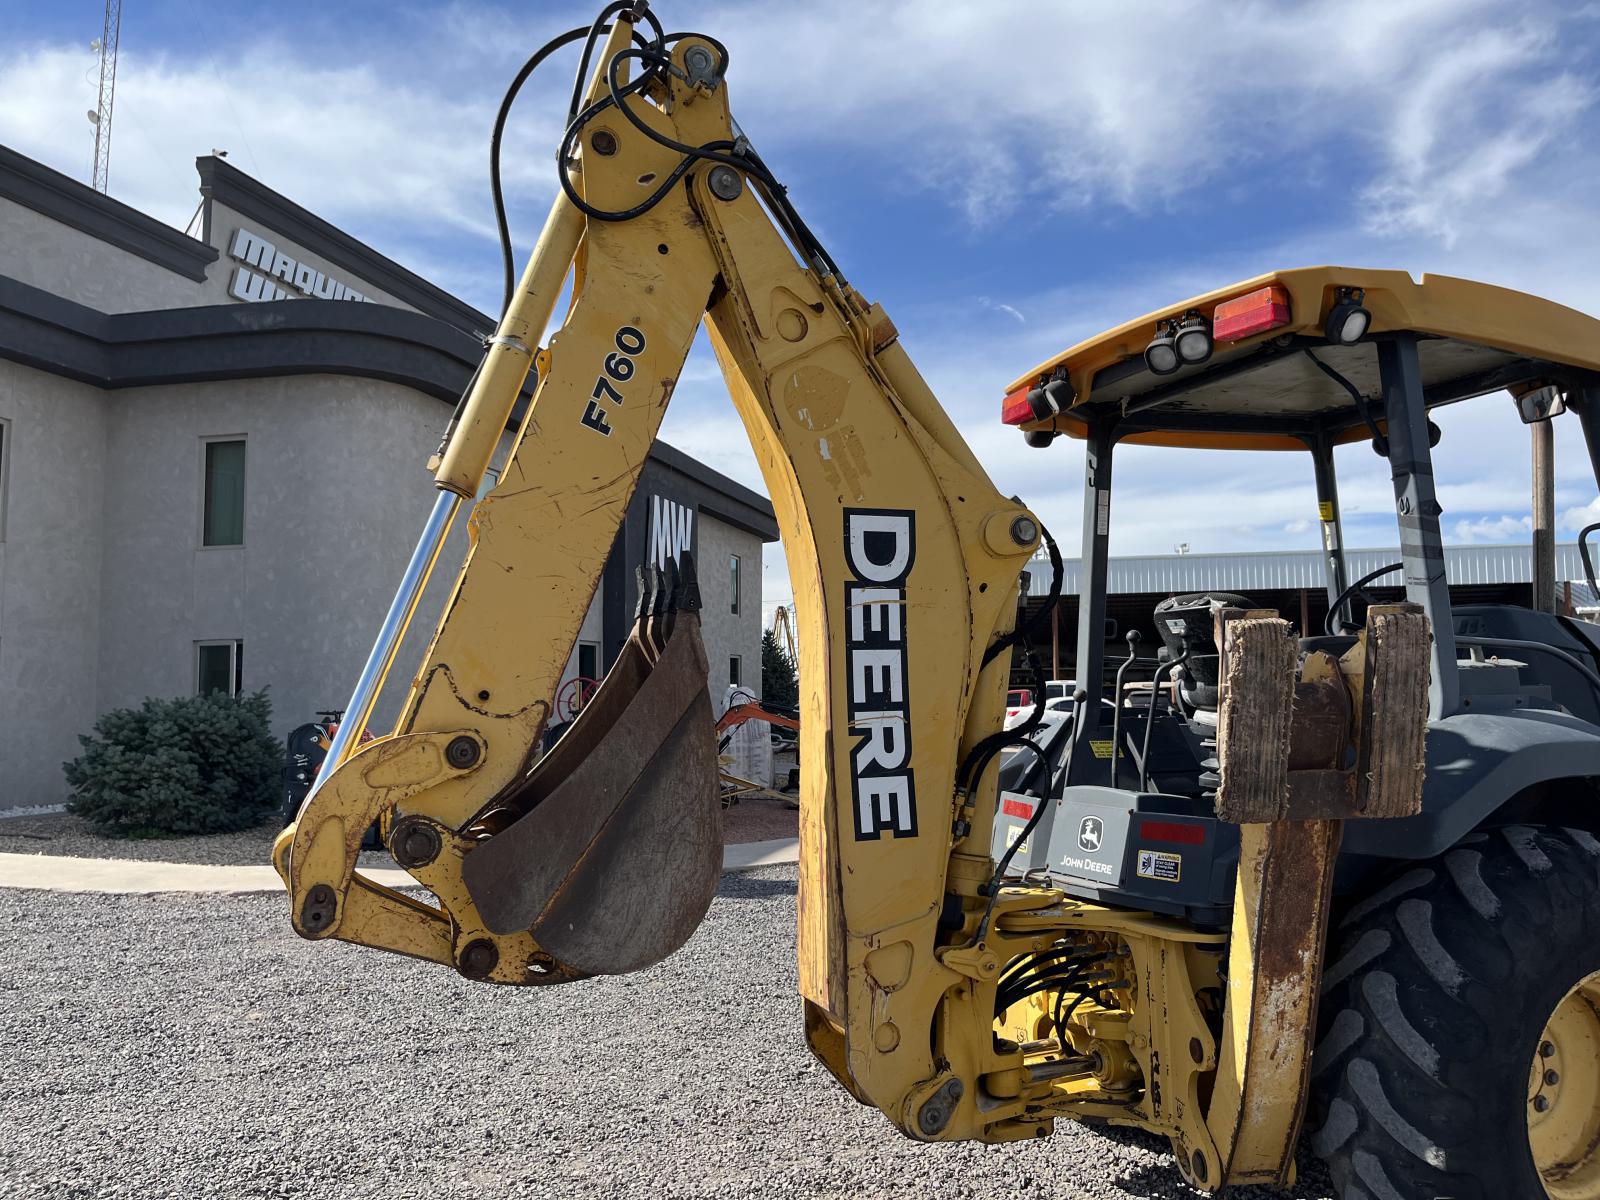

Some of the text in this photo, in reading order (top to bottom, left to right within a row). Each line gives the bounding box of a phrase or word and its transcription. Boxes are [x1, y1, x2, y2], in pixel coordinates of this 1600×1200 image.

[233, 228, 376, 304] MAQUIN
[581, 326, 647, 437] F760
[650, 494, 692, 572] MW
[847, 511, 914, 837] DEERE
[1060, 855, 1113, 875] JOHN DEERE
